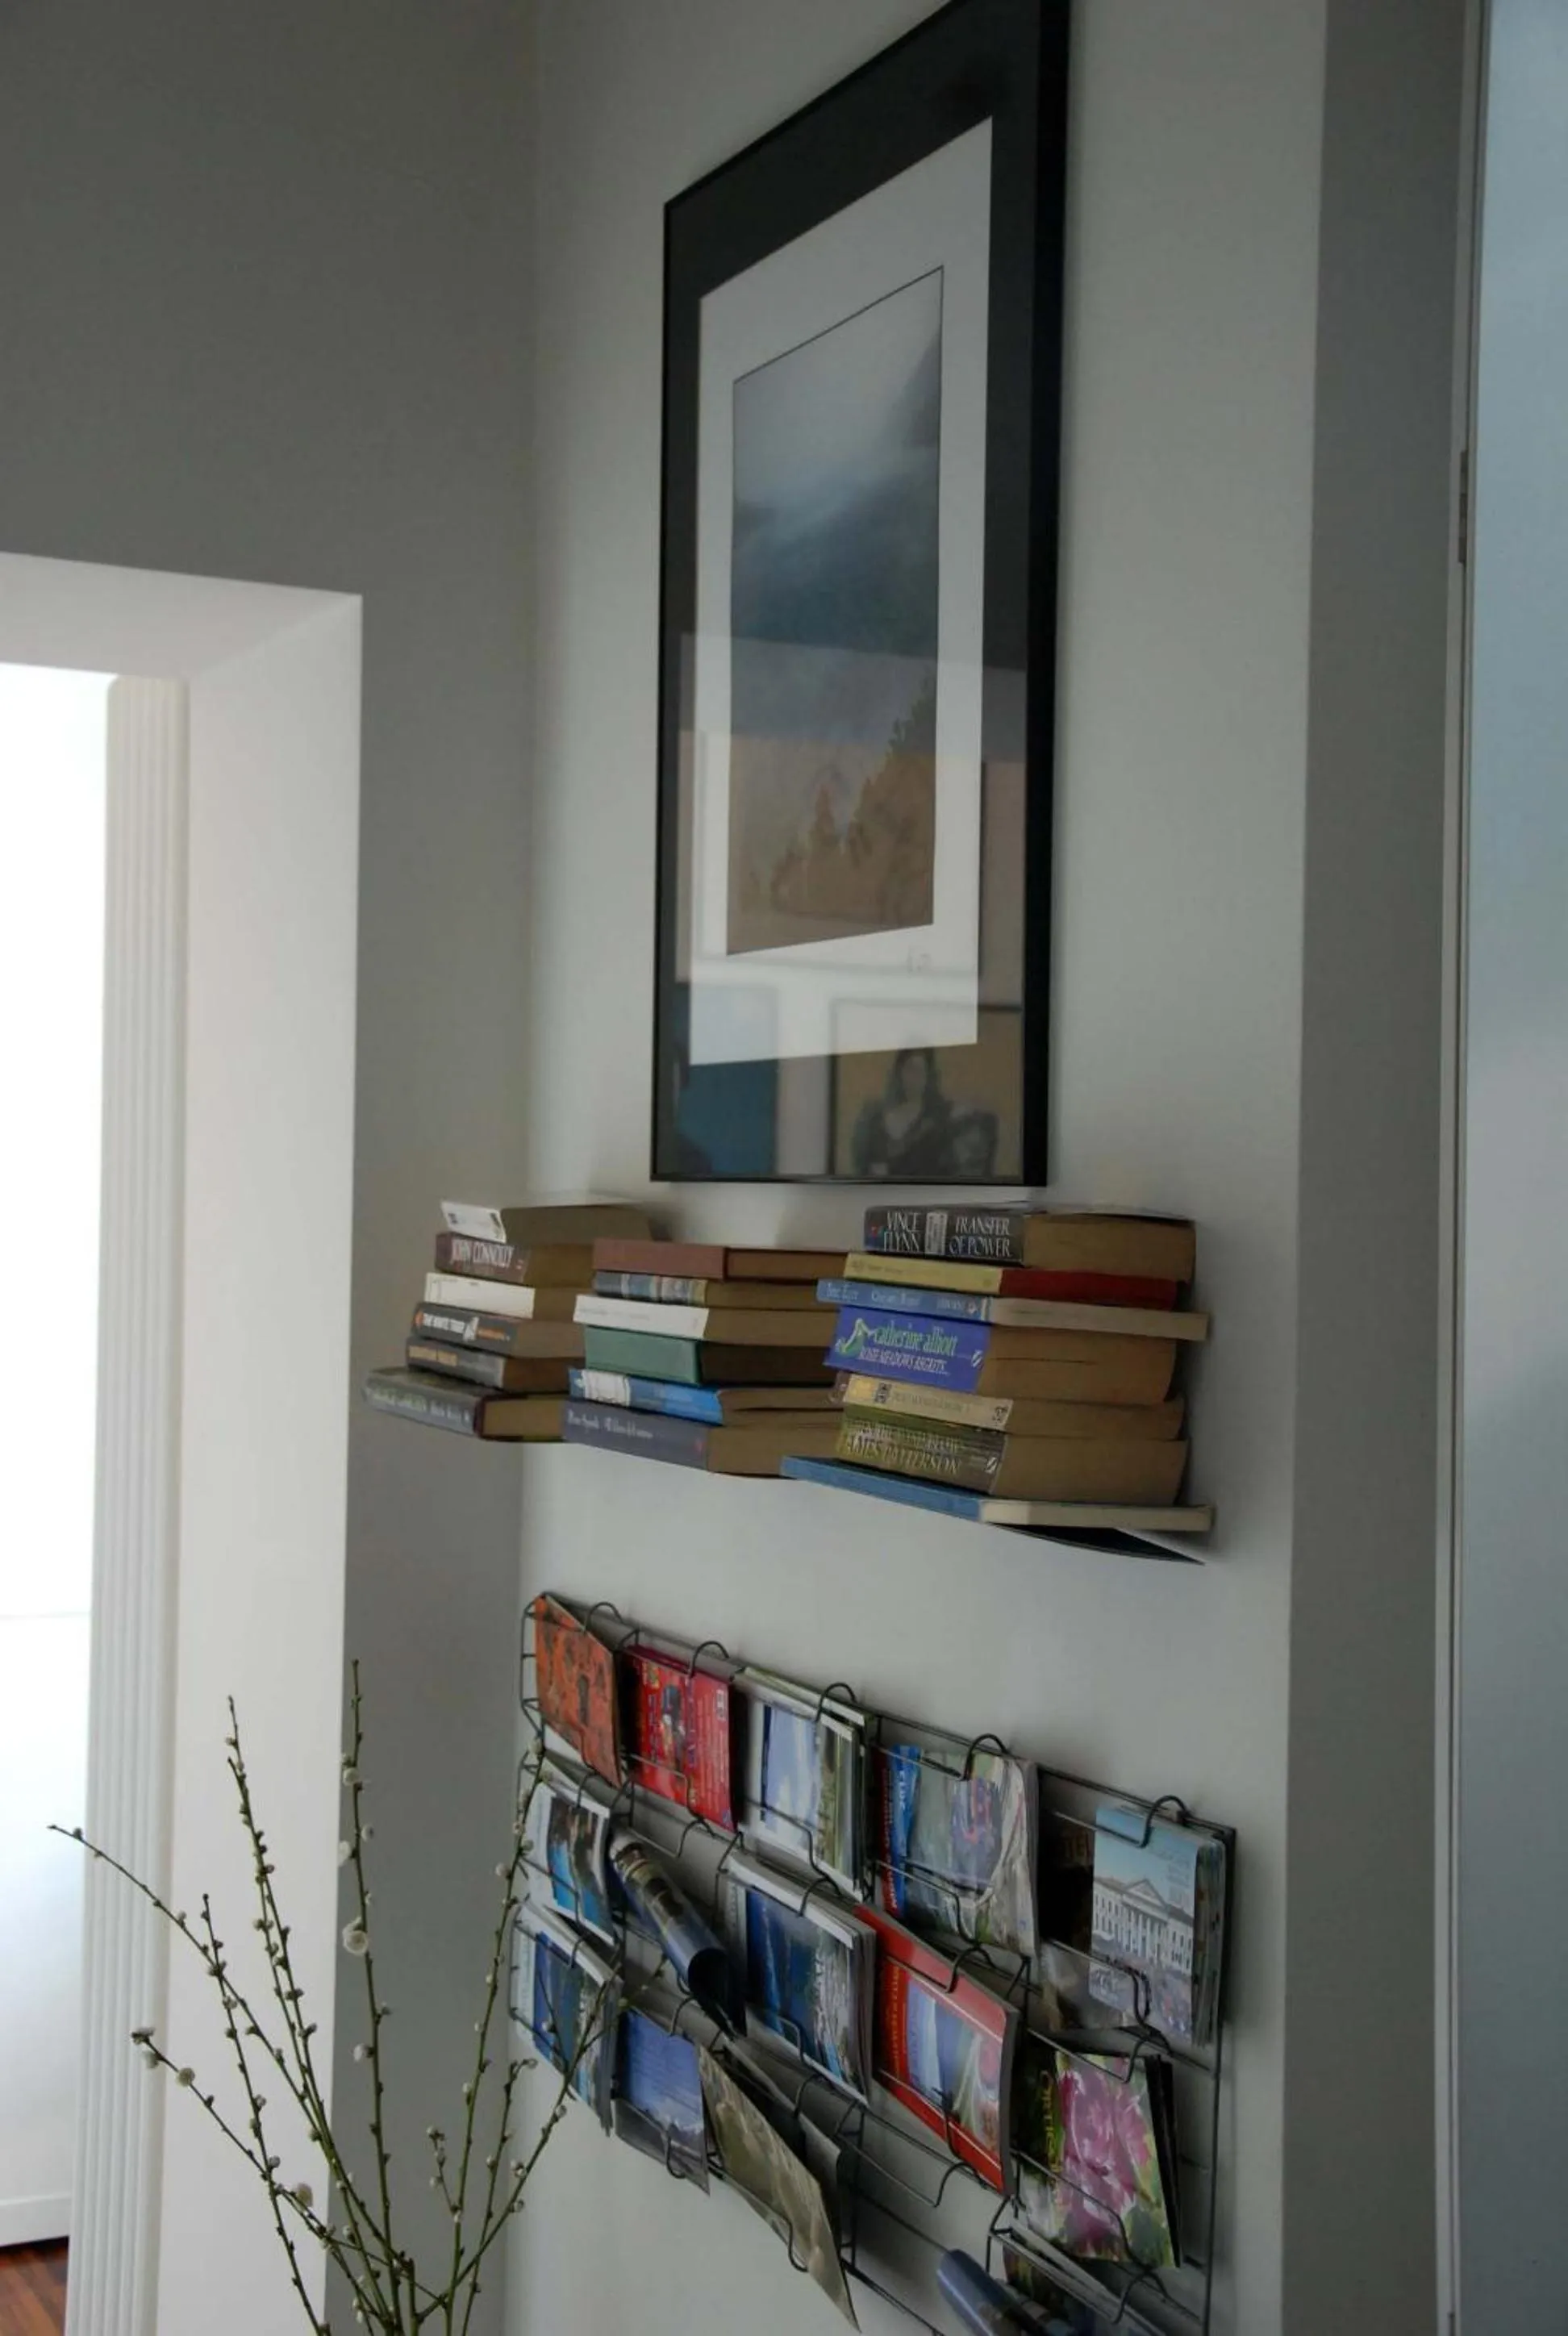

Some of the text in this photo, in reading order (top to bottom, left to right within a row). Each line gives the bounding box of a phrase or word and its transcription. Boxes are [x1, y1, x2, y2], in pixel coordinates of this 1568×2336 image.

[886, 1211, 921, 1232] VINCE
[955, 1216, 1011, 1236] TRANSFER
[884, 1230, 920, 1252] FLYNN
[949, 1235, 1011, 1258] OF POWER
